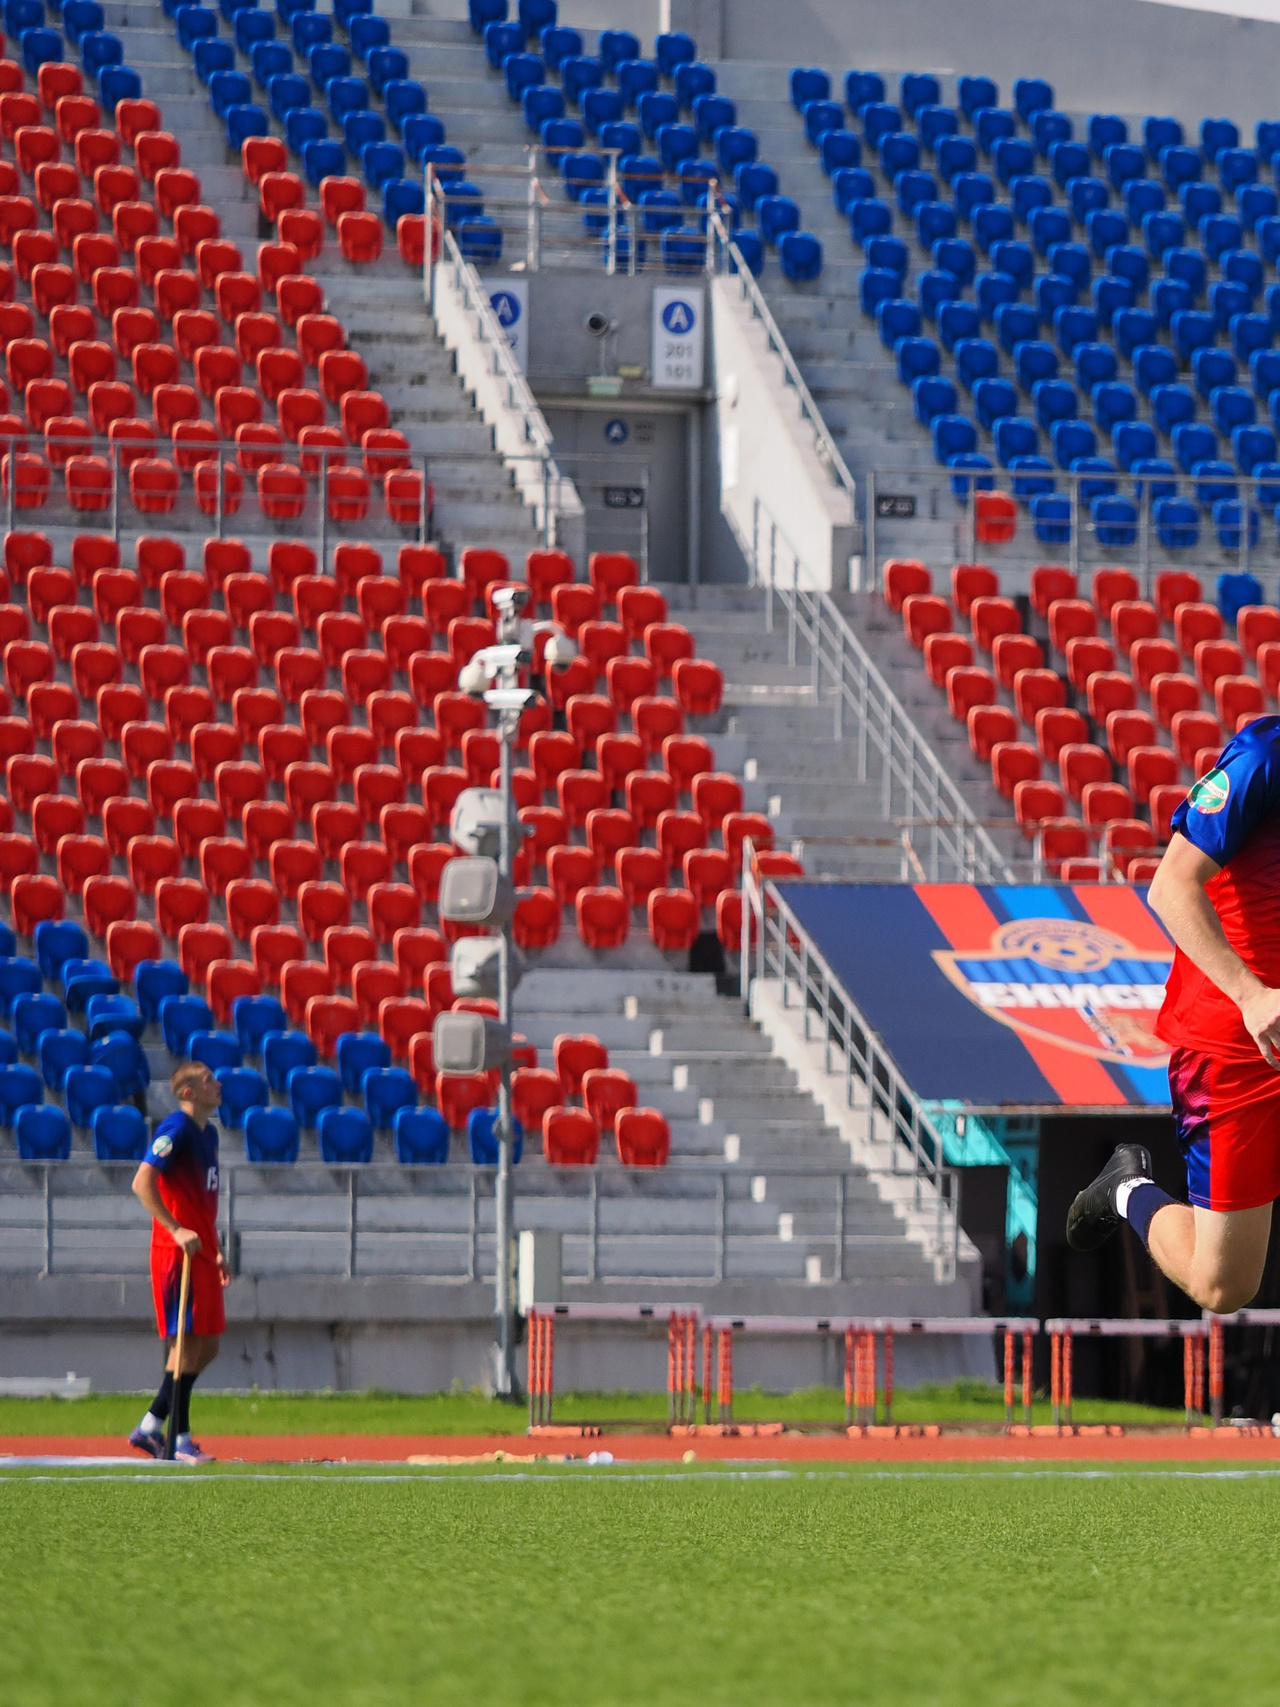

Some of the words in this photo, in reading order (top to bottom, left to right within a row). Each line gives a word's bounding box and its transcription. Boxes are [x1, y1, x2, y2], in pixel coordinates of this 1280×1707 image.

[665, 342, 693, 359] 201
[666, 363, 693, 380] 101
[207, 1166, 218, 1192] 15
